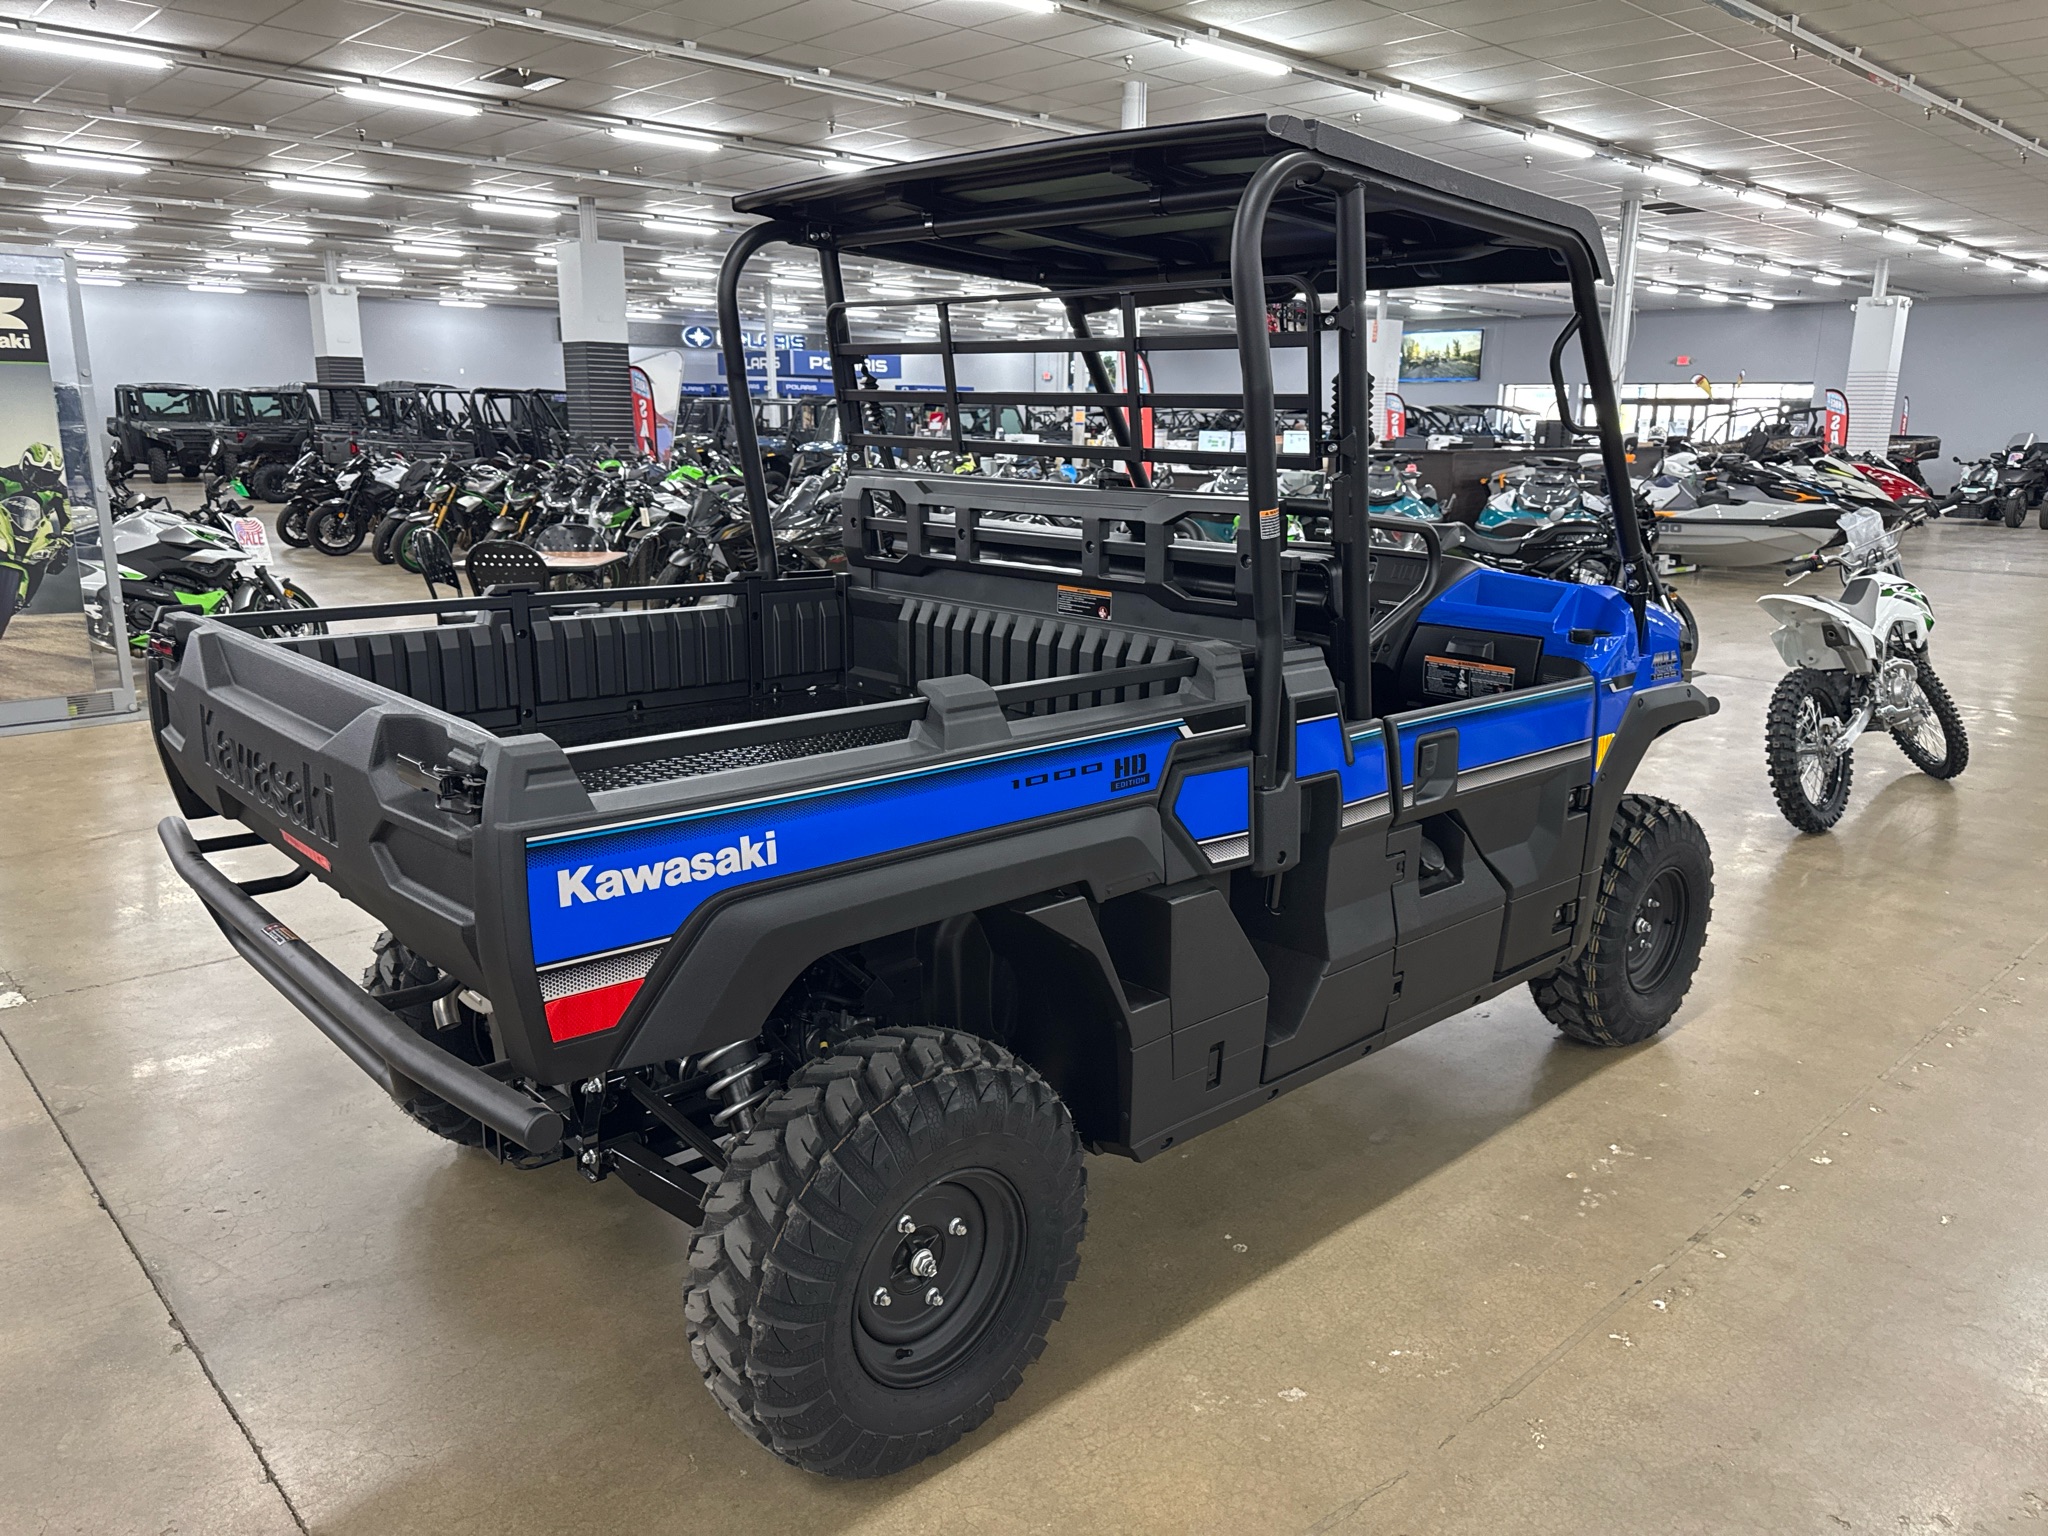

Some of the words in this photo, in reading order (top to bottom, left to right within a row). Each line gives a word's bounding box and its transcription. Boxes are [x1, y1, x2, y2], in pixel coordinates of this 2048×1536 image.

[786, 383, 818, 391] POLARIS
[239, 531, 264, 546] SALE
[200, 703, 339, 848] Kawasaki
[1011, 762, 1102, 789] 1000
[1114, 753, 1147, 779] HD
[1115, 777, 1146, 789] EDITION
[557, 830, 778, 908] Kawasaki
